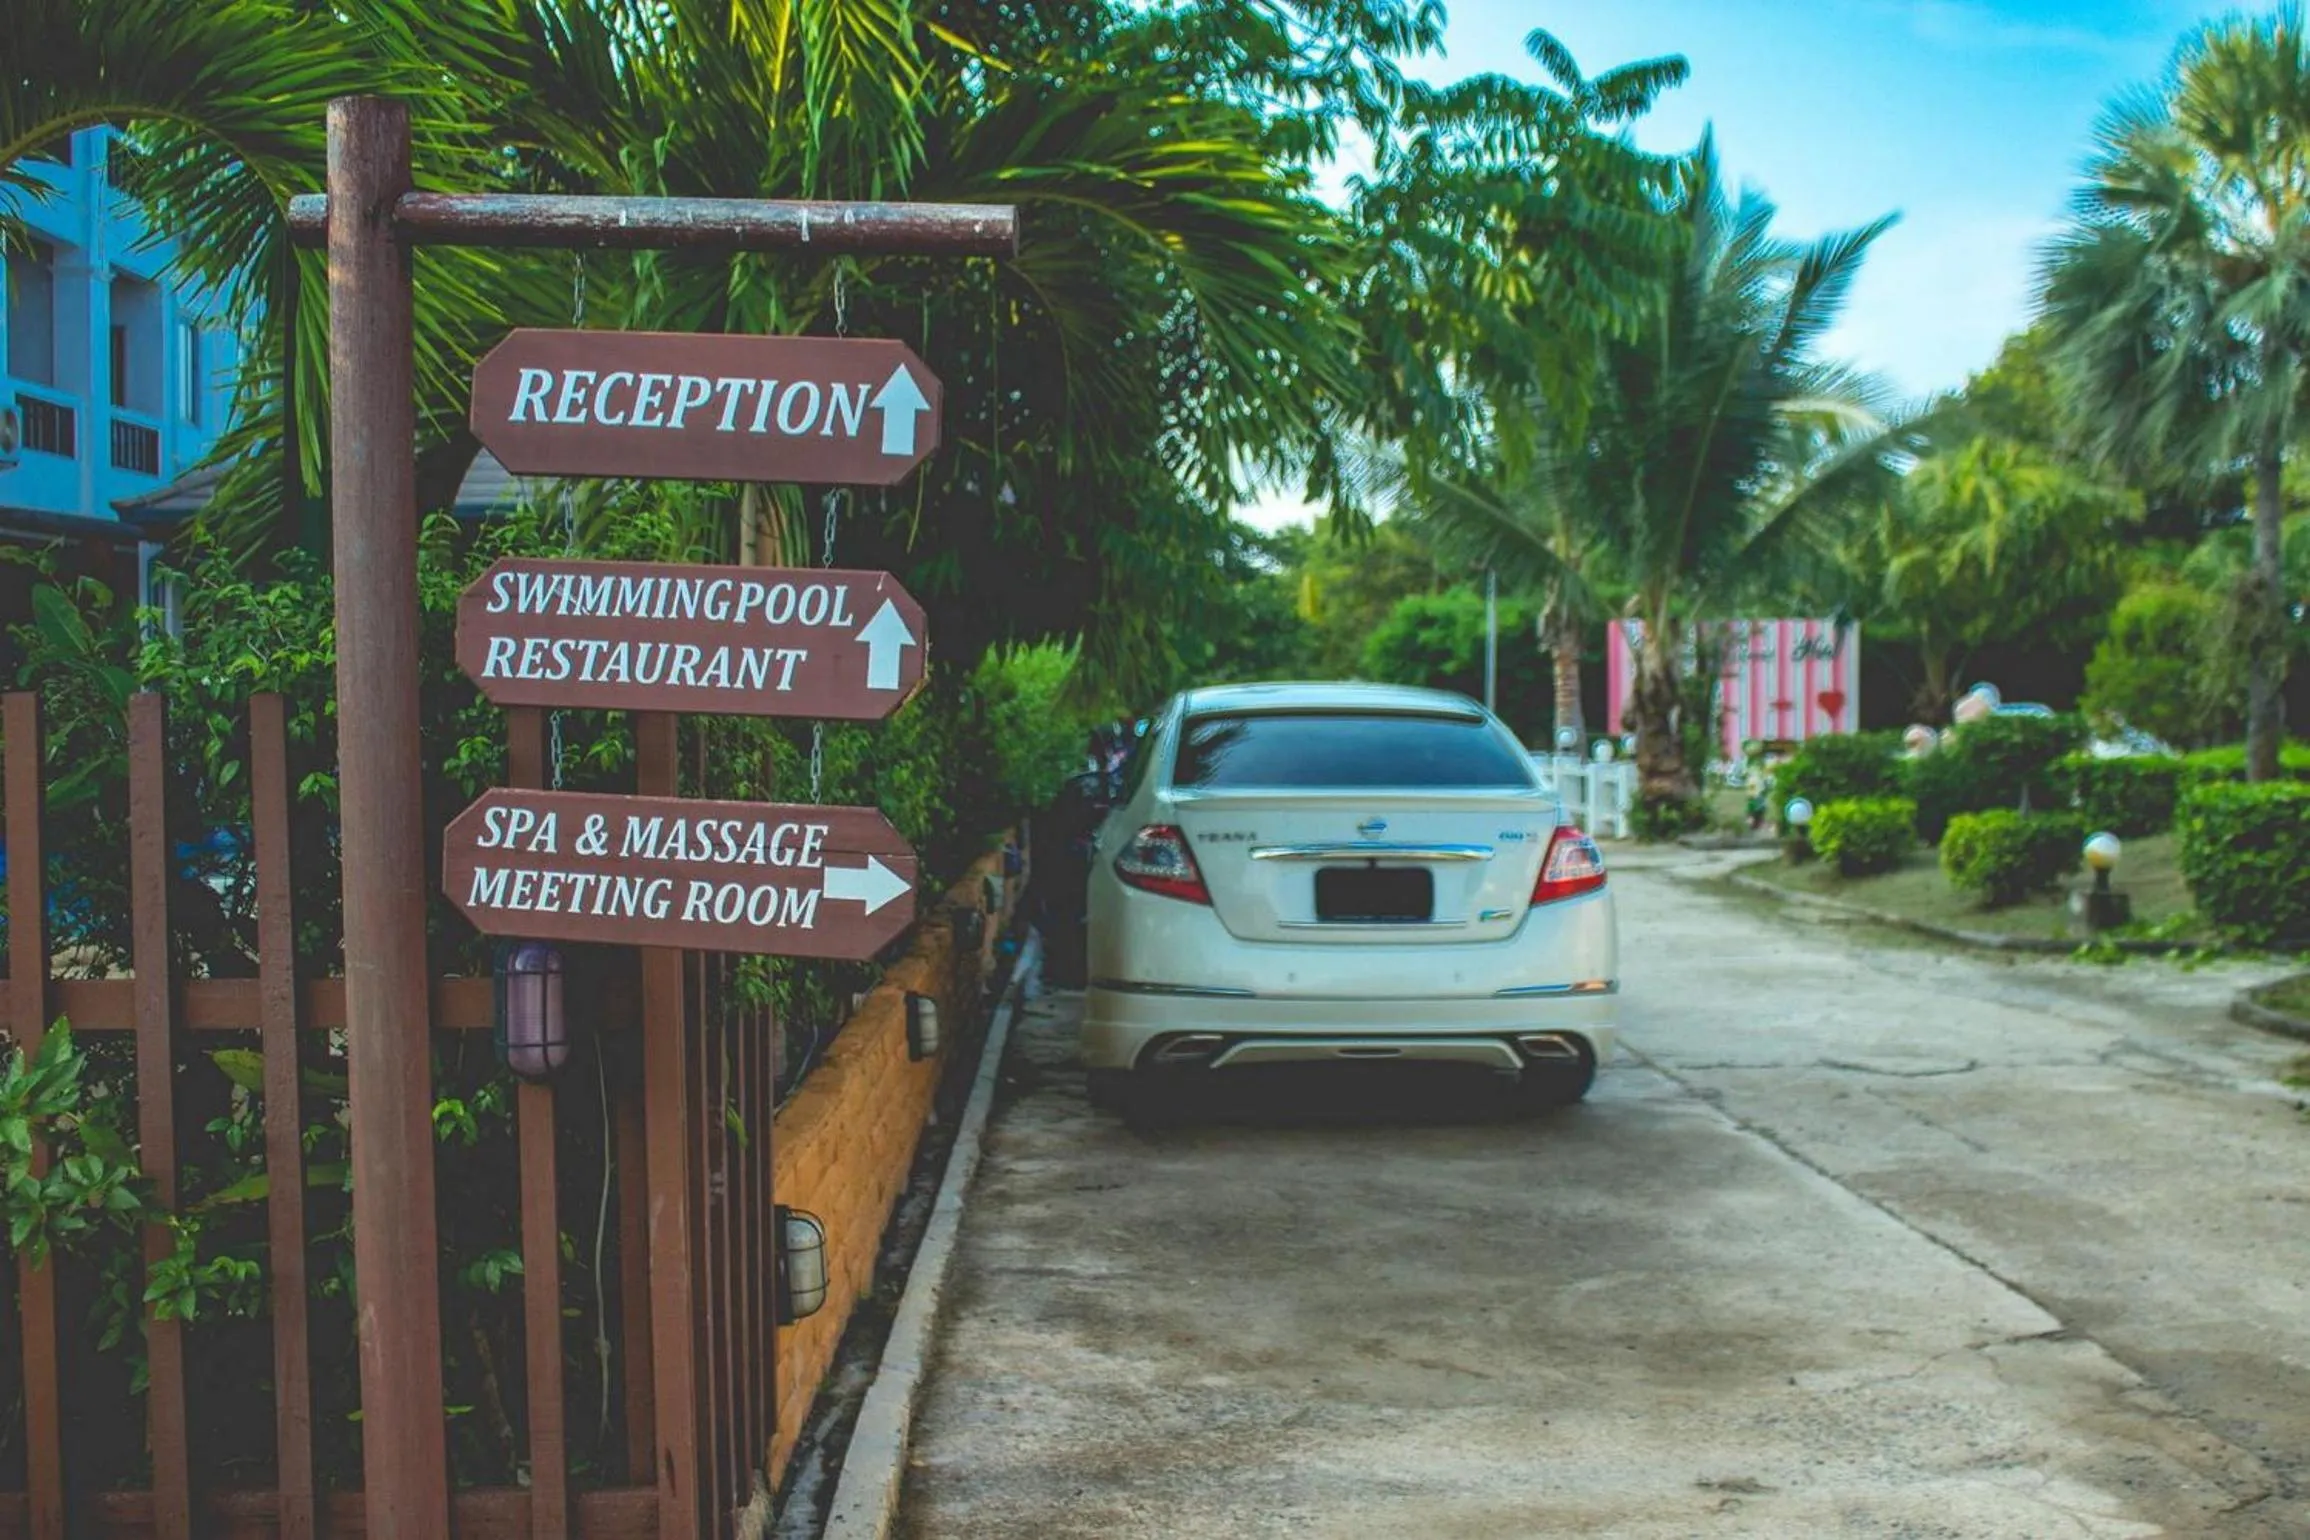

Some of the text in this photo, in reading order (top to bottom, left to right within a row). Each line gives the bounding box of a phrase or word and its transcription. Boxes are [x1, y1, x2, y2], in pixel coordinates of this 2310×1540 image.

[508, 367, 872, 437] RECEPTION
[481, 636, 807, 691] RESTAURANT
[476, 806, 829, 869] SPA & MASSAGE
[466, 866, 822, 930] MEETING ROOM
